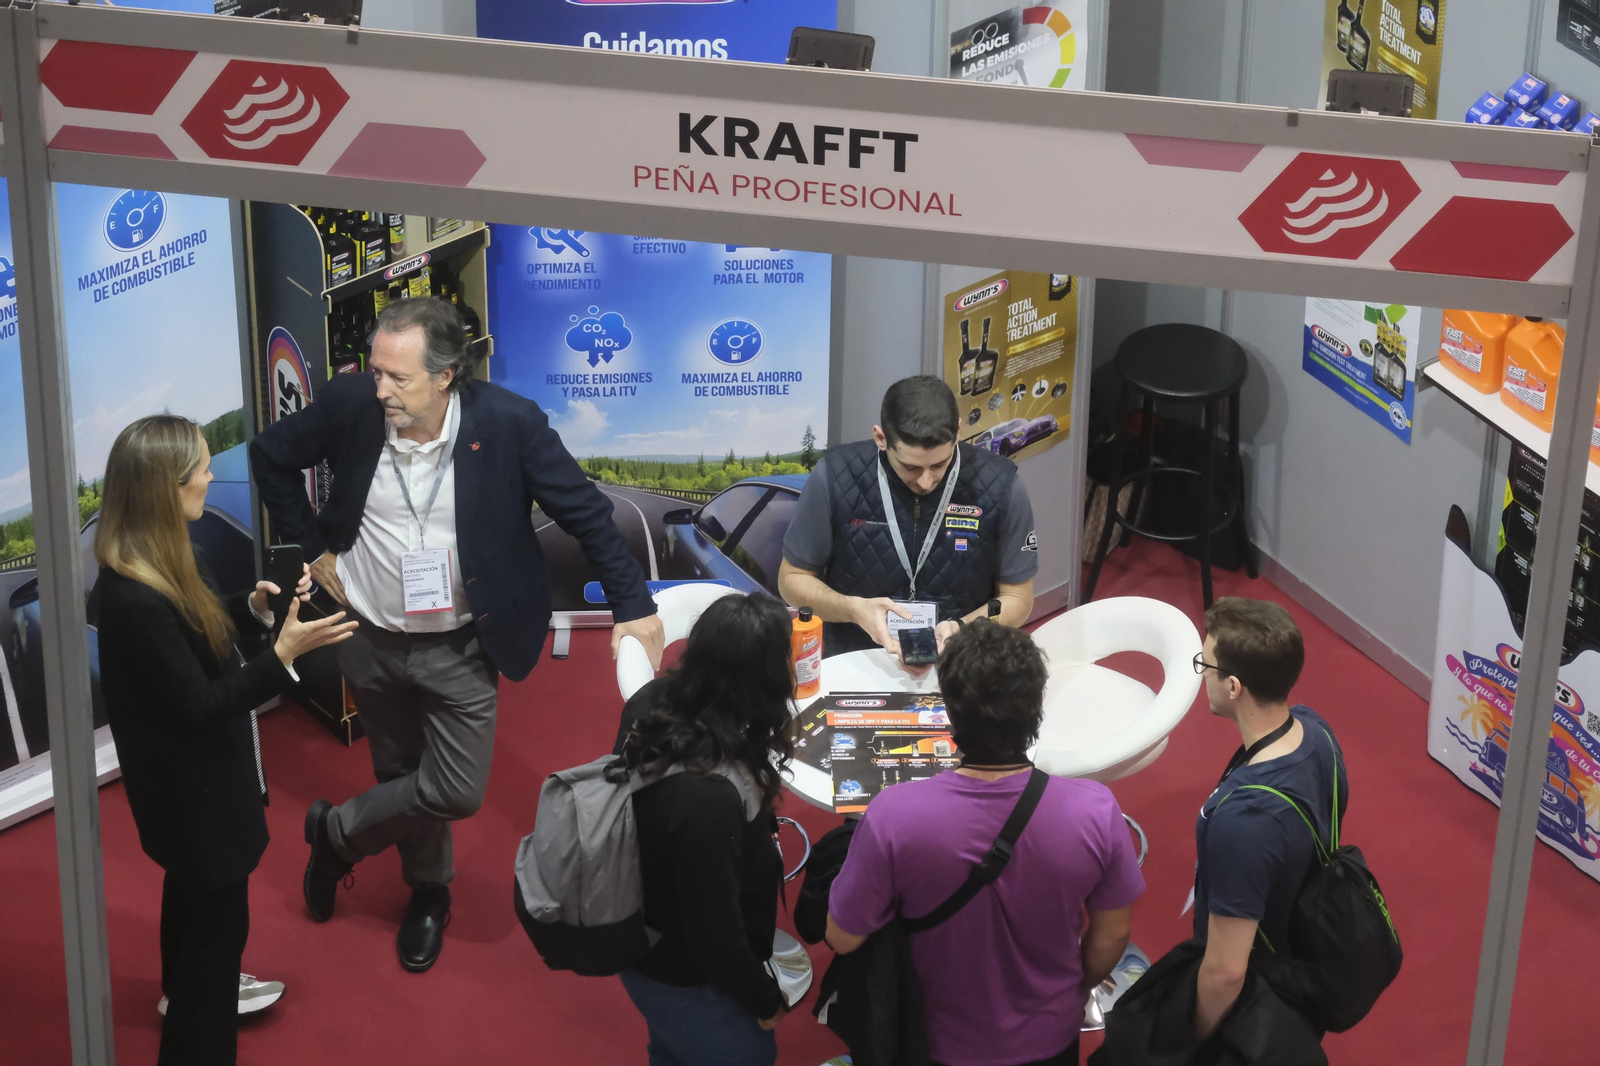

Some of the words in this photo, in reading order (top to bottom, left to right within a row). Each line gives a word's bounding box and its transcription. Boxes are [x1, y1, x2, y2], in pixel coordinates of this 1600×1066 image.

[1382, 0, 1402, 25] TOTAL
[1380, 13, 1405, 41] ACTION
[962, 32, 1010, 61] REDUCE
[962, 59, 985, 78] LAS
[986, 32, 1050, 68] EMISIONES
[1379, 26, 1422, 65] TREATMENT
[679, 112, 919, 173] KRAFFT
[633, 164, 720, 195] PEÑA
[732, 174, 962, 217] PROFESIONAL
[632, 243, 687, 254] EFECTIVO
[77, 255, 140, 291] MAXIMIZA
[141, 249, 157, 266] EL
[158, 229, 208, 260] AHORRO
[527, 263, 582, 275] OPTIMIZA
[583, 263, 598, 274] EL
[724, 259, 794, 271] SOLUCIONES
[93, 285, 110, 304] DE
[111, 251, 196, 296] COMBUSTIBLE
[524, 279, 601, 291] RENDIMIENTO
[713, 273, 743, 285] PARA
[745, 273, 759, 284] EL
[764, 272, 804, 284] MOTOR
[1007, 297, 1034, 317] TOTAL
[1006, 308, 1038, 331] ACTION
[1006, 313, 1058, 343] TREATMENT
[1446, 326, 1464, 339] FAST
[546, 374, 590, 385] REDUCE
[592, 372, 653, 385] EMISIONES
[681, 373, 739, 384] MAXIMIZA
[741, 372, 755, 383] EL
[756, 371, 803, 382] AHORRO
[1508, 365, 1528, 378] FAST
[562, 387, 570, 398] Y
[571, 387, 600, 398] PASA
[602, 386, 617, 398] LA
[619, 385, 637, 397] ITV
[694, 386, 709, 397] DE
[711, 384, 790, 397] COMBUSTIBLE
[404, 566, 439, 575] ACREDITACIÓN
[431, 600, 438, 608] X
[1462, 672, 1472, 686] lo
[1473, 683, 1494, 700] que
[1494, 698, 1508, 712] no
[1553, 712, 1574, 731] que
[1565, 748, 1578, 763] de
[1578, 758, 1591, 773] tu
